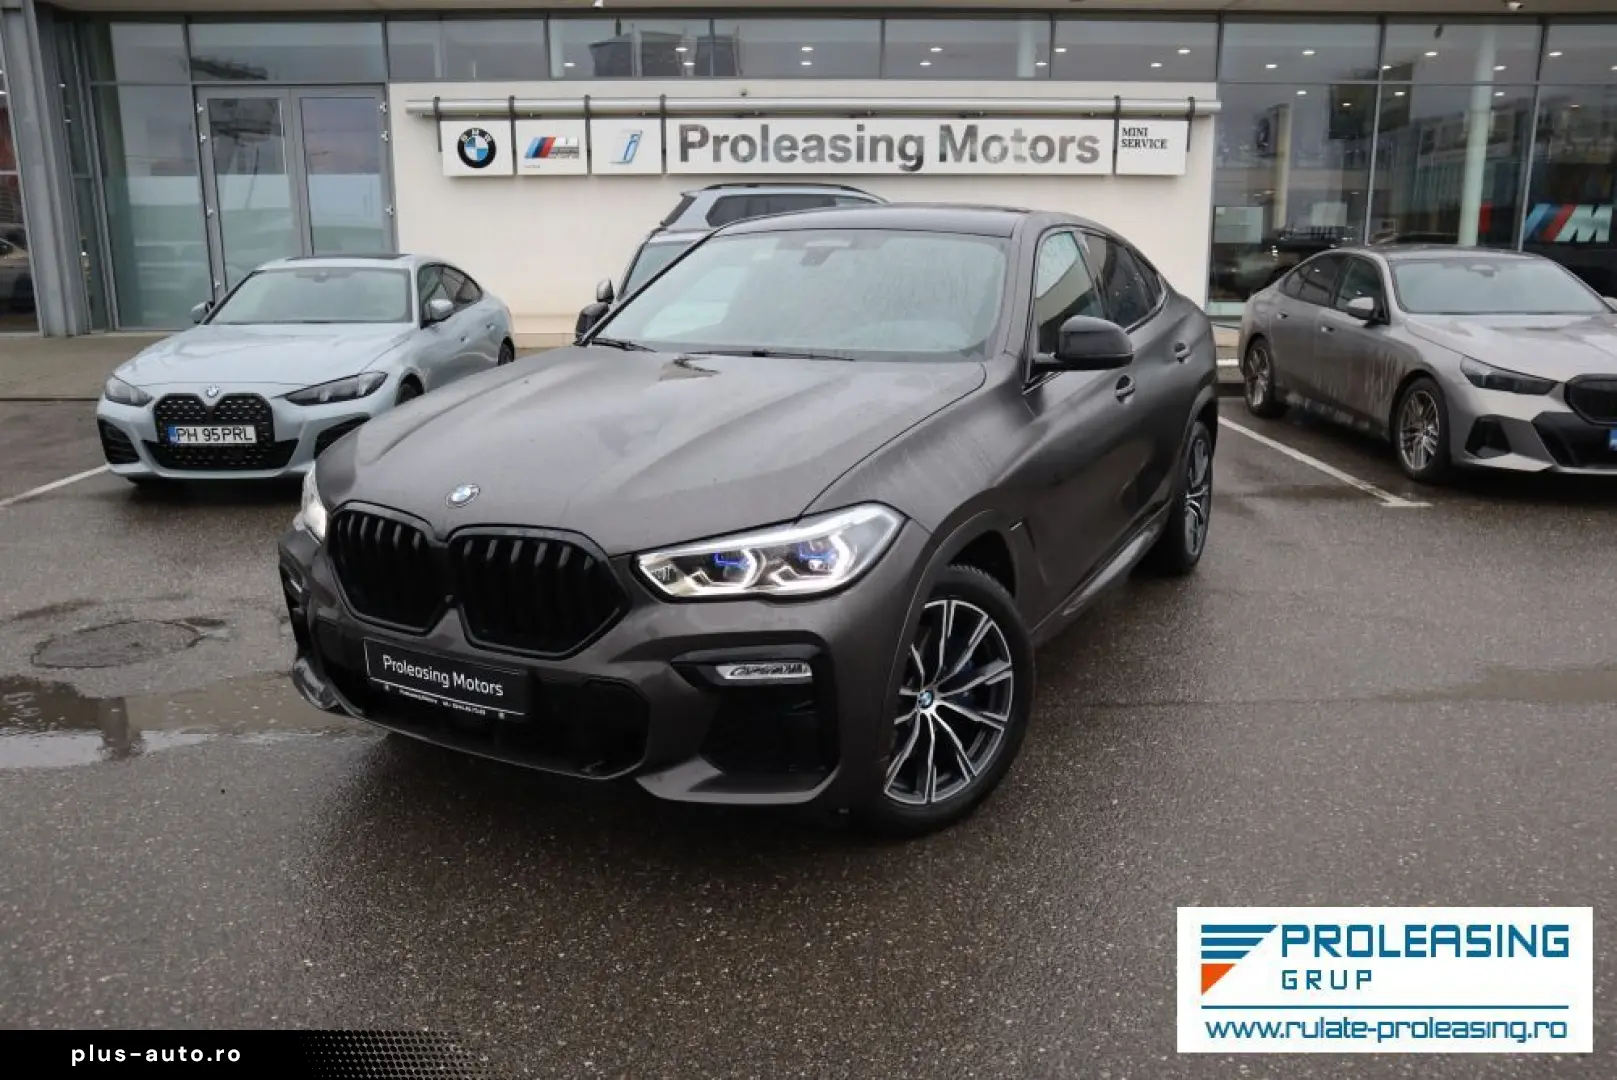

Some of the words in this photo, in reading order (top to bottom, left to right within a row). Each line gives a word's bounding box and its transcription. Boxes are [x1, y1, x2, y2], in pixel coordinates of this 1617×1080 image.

[1122, 127, 1148, 137] MINI
[679, 123, 924, 172] Proleasing
[938, 123, 1100, 164] Motors
[1121, 138, 1168, 149] SERVICE
[177, 428, 198, 442] PH
[382, 654, 450, 688] Proleasing
[452, 671, 504, 696] Motors
